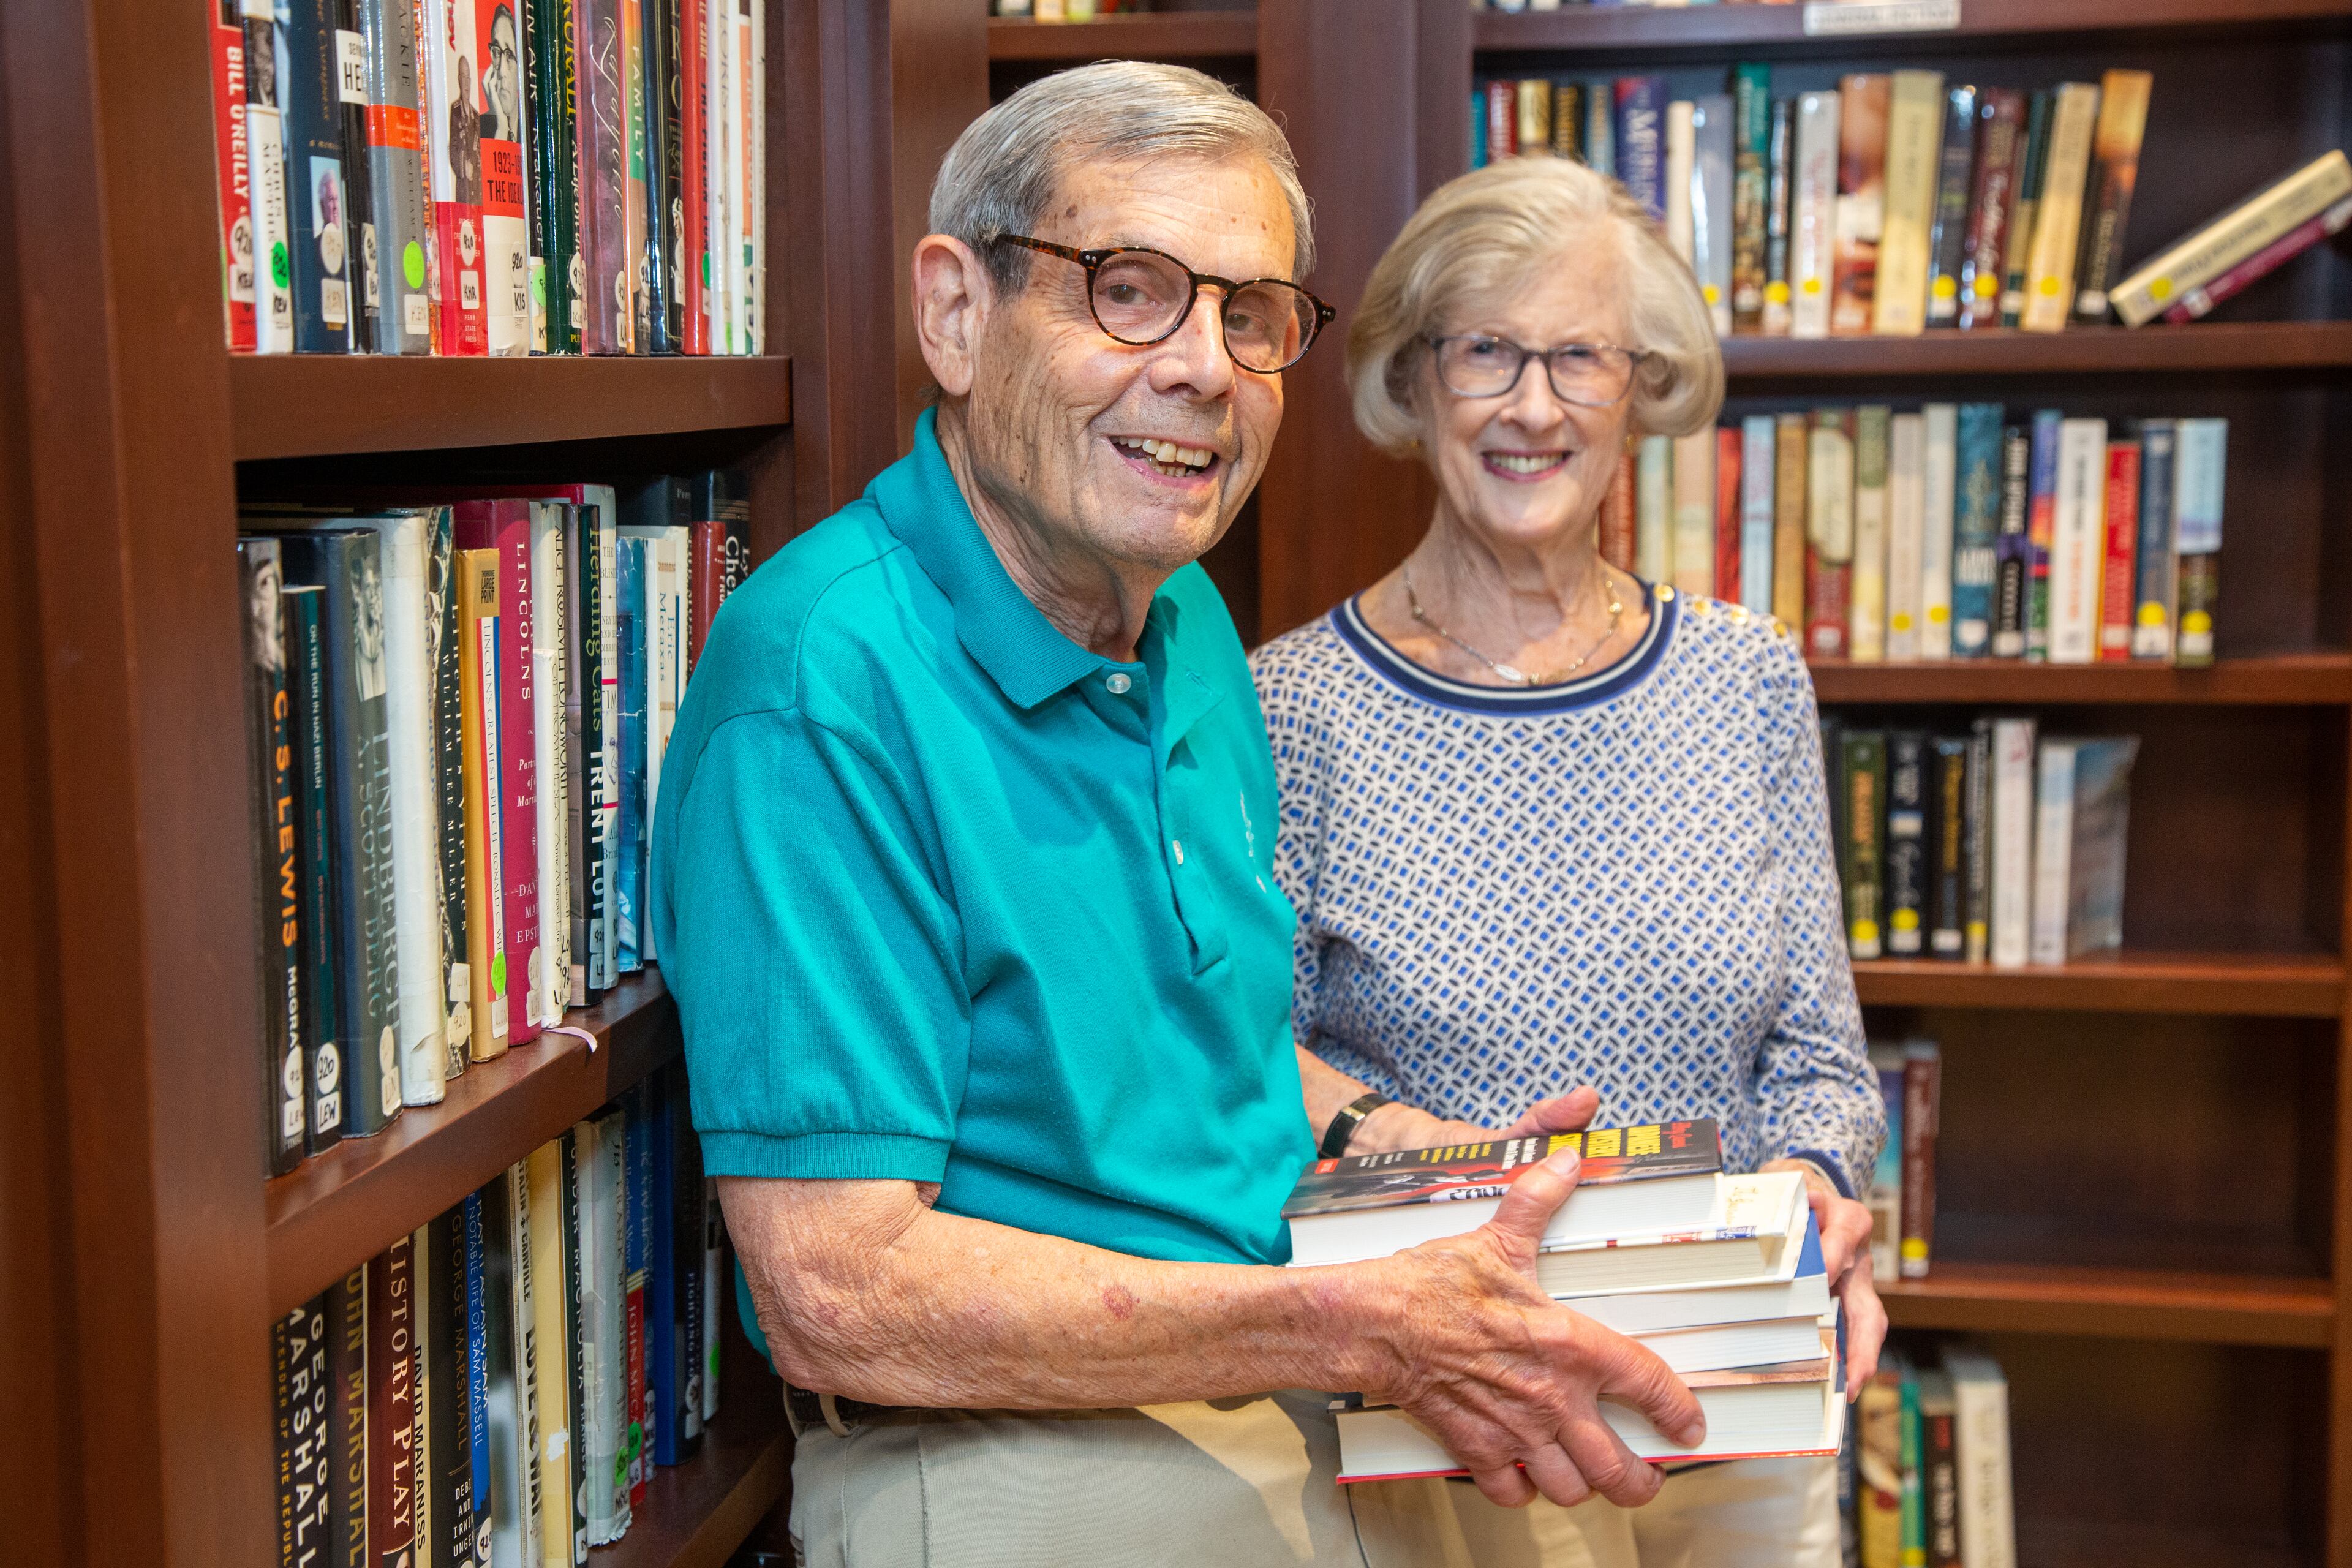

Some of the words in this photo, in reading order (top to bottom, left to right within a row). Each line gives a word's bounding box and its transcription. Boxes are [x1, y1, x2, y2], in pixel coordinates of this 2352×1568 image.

[227, 46, 244, 96] BILL
[632, 45, 643, 160] FAMILY
[230, 104, 249, 198] O'REILLY
[487, 179, 506, 202] THE
[512, 252, 523, 271] 920
[464, 284, 477, 300] KHR
[514, 292, 526, 311] KIS
[601, 546, 614, 558] THE
[481, 578, 494, 589] LARGE
[481, 589, 495, 603] PRINT
[586, 527, 601, 657] Herding
[309, 624, 317, 643] ON
[516, 541, 531, 701] LINCOLNS
[483, 624, 492, 704] LINCOLN'S
[274, 690, 289, 734] C.
[312, 701, 320, 714] IN
[442, 653, 452, 752] WILLIAM
[592, 666, 602, 732] Cats
[312, 716, 321, 743] NAZI
[486, 709, 496, 781] GREATEST
[275, 744, 292, 785] S.
[313, 746, 322, 789] BERLIN
[445, 767, 453, 805] LEE
[590, 750, 604, 844] TRENT
[277, 795, 299, 948] LEWIS
[372, 731, 401, 1030] LINDBERGH
[447, 819, 457, 902] MILLER
[492, 852, 501, 907] RONALD
[591, 860, 605, 911] LOT
[454, 1014, 466, 1030] 920
[317, 1055, 334, 1081] 920
[319, 1100, 336, 1129] LEW
[468, 1205, 478, 1278] NOTABLE
[521, 1231, 532, 1303] CARVILLE
[470, 1282, 479, 1308] LIFE
[472, 1313, 480, 1331] OF
[628, 1305, 638, 1362] JOHN
[277, 1323, 287, 1409] EFENDER
[415, 1344, 424, 1417] DAVID
[472, 1338, 481, 1372] SAM
[454, 1327, 467, 1452] MARSHALL
[473, 1378, 483, 1447] MASSELL
[279, 1418, 289, 1439] OF
[311, 1313, 329, 1526] GEORGE
[281, 1450, 290, 1484] THE
[347, 1371, 366, 1568] MARSHAL
[393, 1420, 412, 1530] PLAY
[415, 1423, 426, 1550] MARANISS
[455, 1477, 472, 1501] DEBI
[282, 1497, 293, 1568] REPUBL
[458, 1498, 471, 1518] AND
